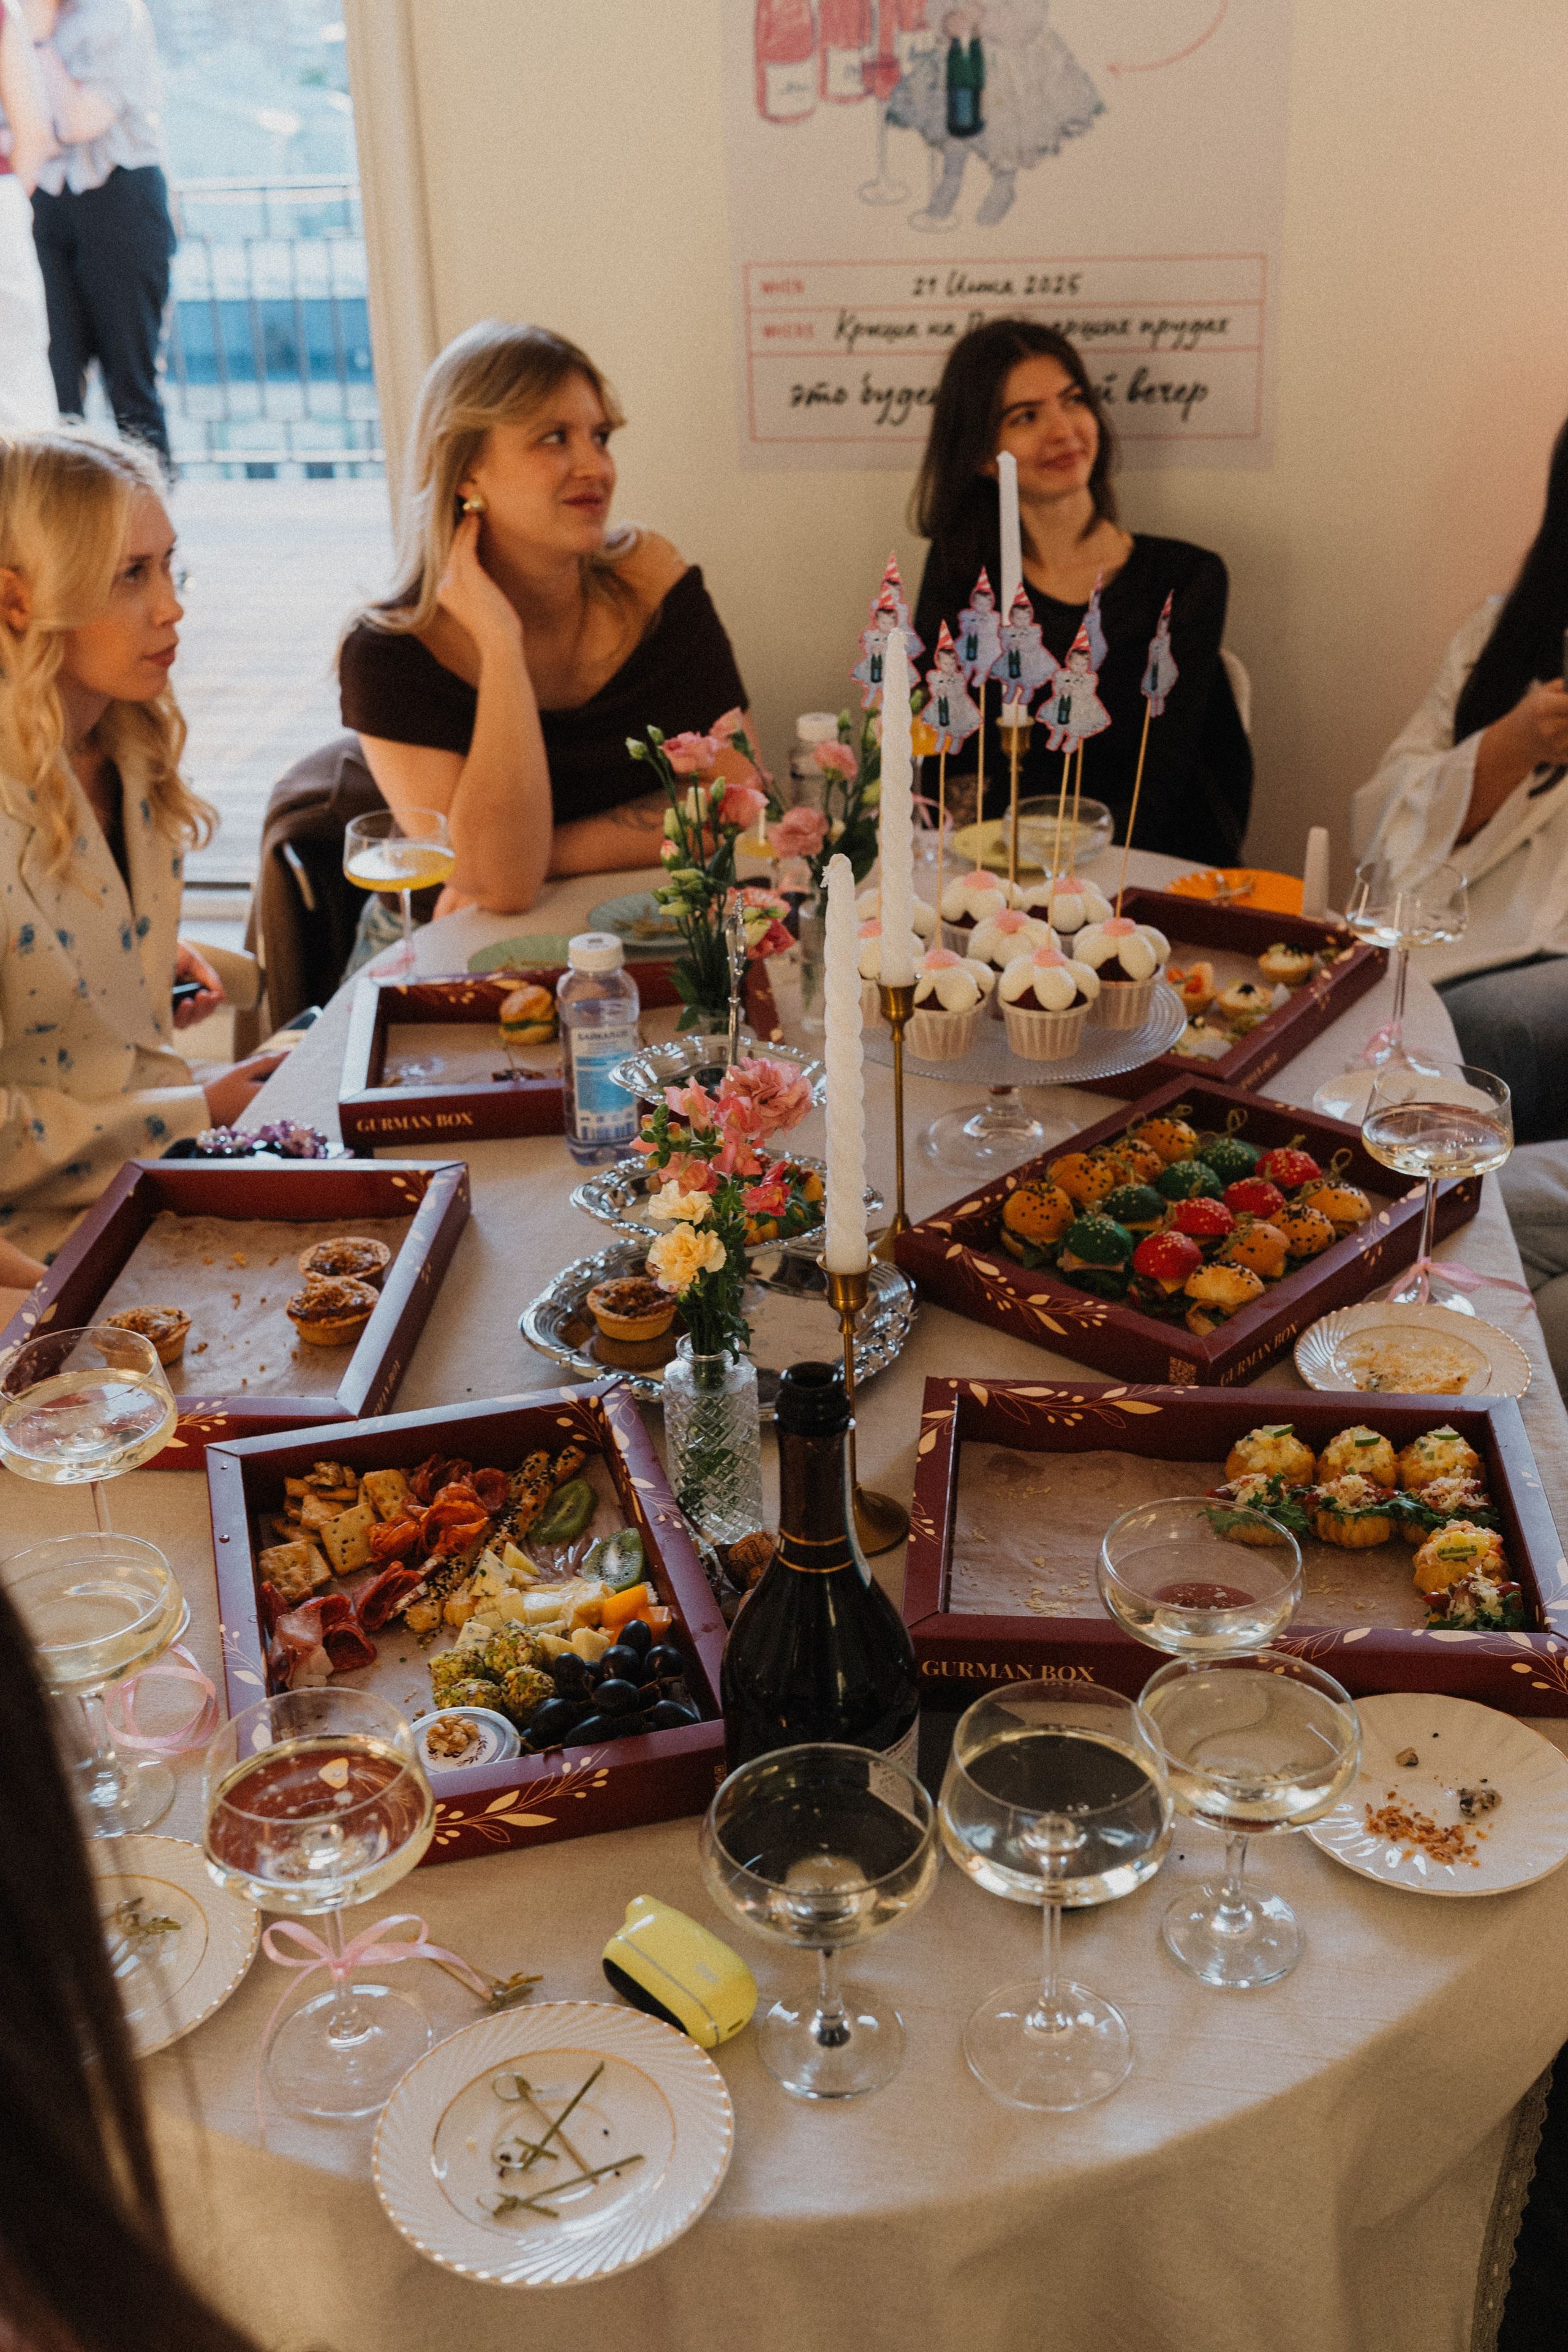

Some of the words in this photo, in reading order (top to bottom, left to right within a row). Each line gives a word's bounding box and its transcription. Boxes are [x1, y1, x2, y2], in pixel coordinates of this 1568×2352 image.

[1024, 273, 1082, 295] 2025
[927, 322, 956, 335] на
[790, 382, 848, 408] это
[860, 372, 939, 426] буде
[1128, 366, 1209, 423] вечер
[356, 1115, 432, 1133] GURMAN
[436, 1112, 473, 1128] BOX
[922, 1660, 1033, 1679] GURMAN
[1041, 1665, 1095, 1681] BOX
